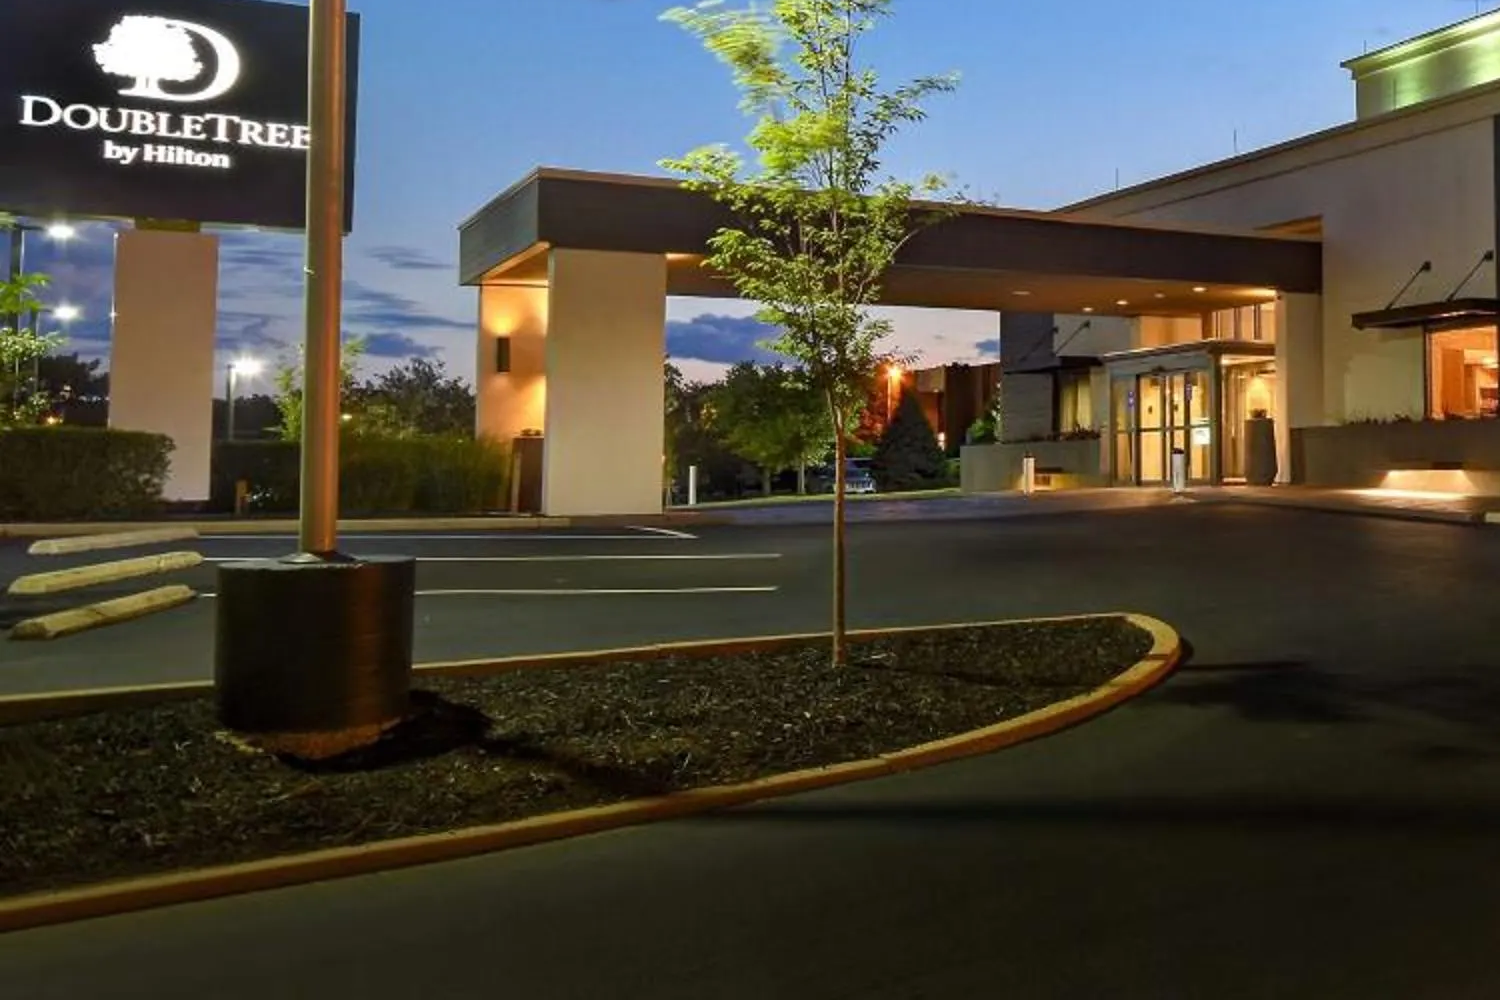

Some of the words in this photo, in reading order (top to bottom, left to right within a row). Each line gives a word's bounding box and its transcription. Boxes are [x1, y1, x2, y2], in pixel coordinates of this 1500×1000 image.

[19, 95, 310, 149] DOUBLETREE
[103, 140, 139, 164] by
[143, 143, 231, 168] Hilton
